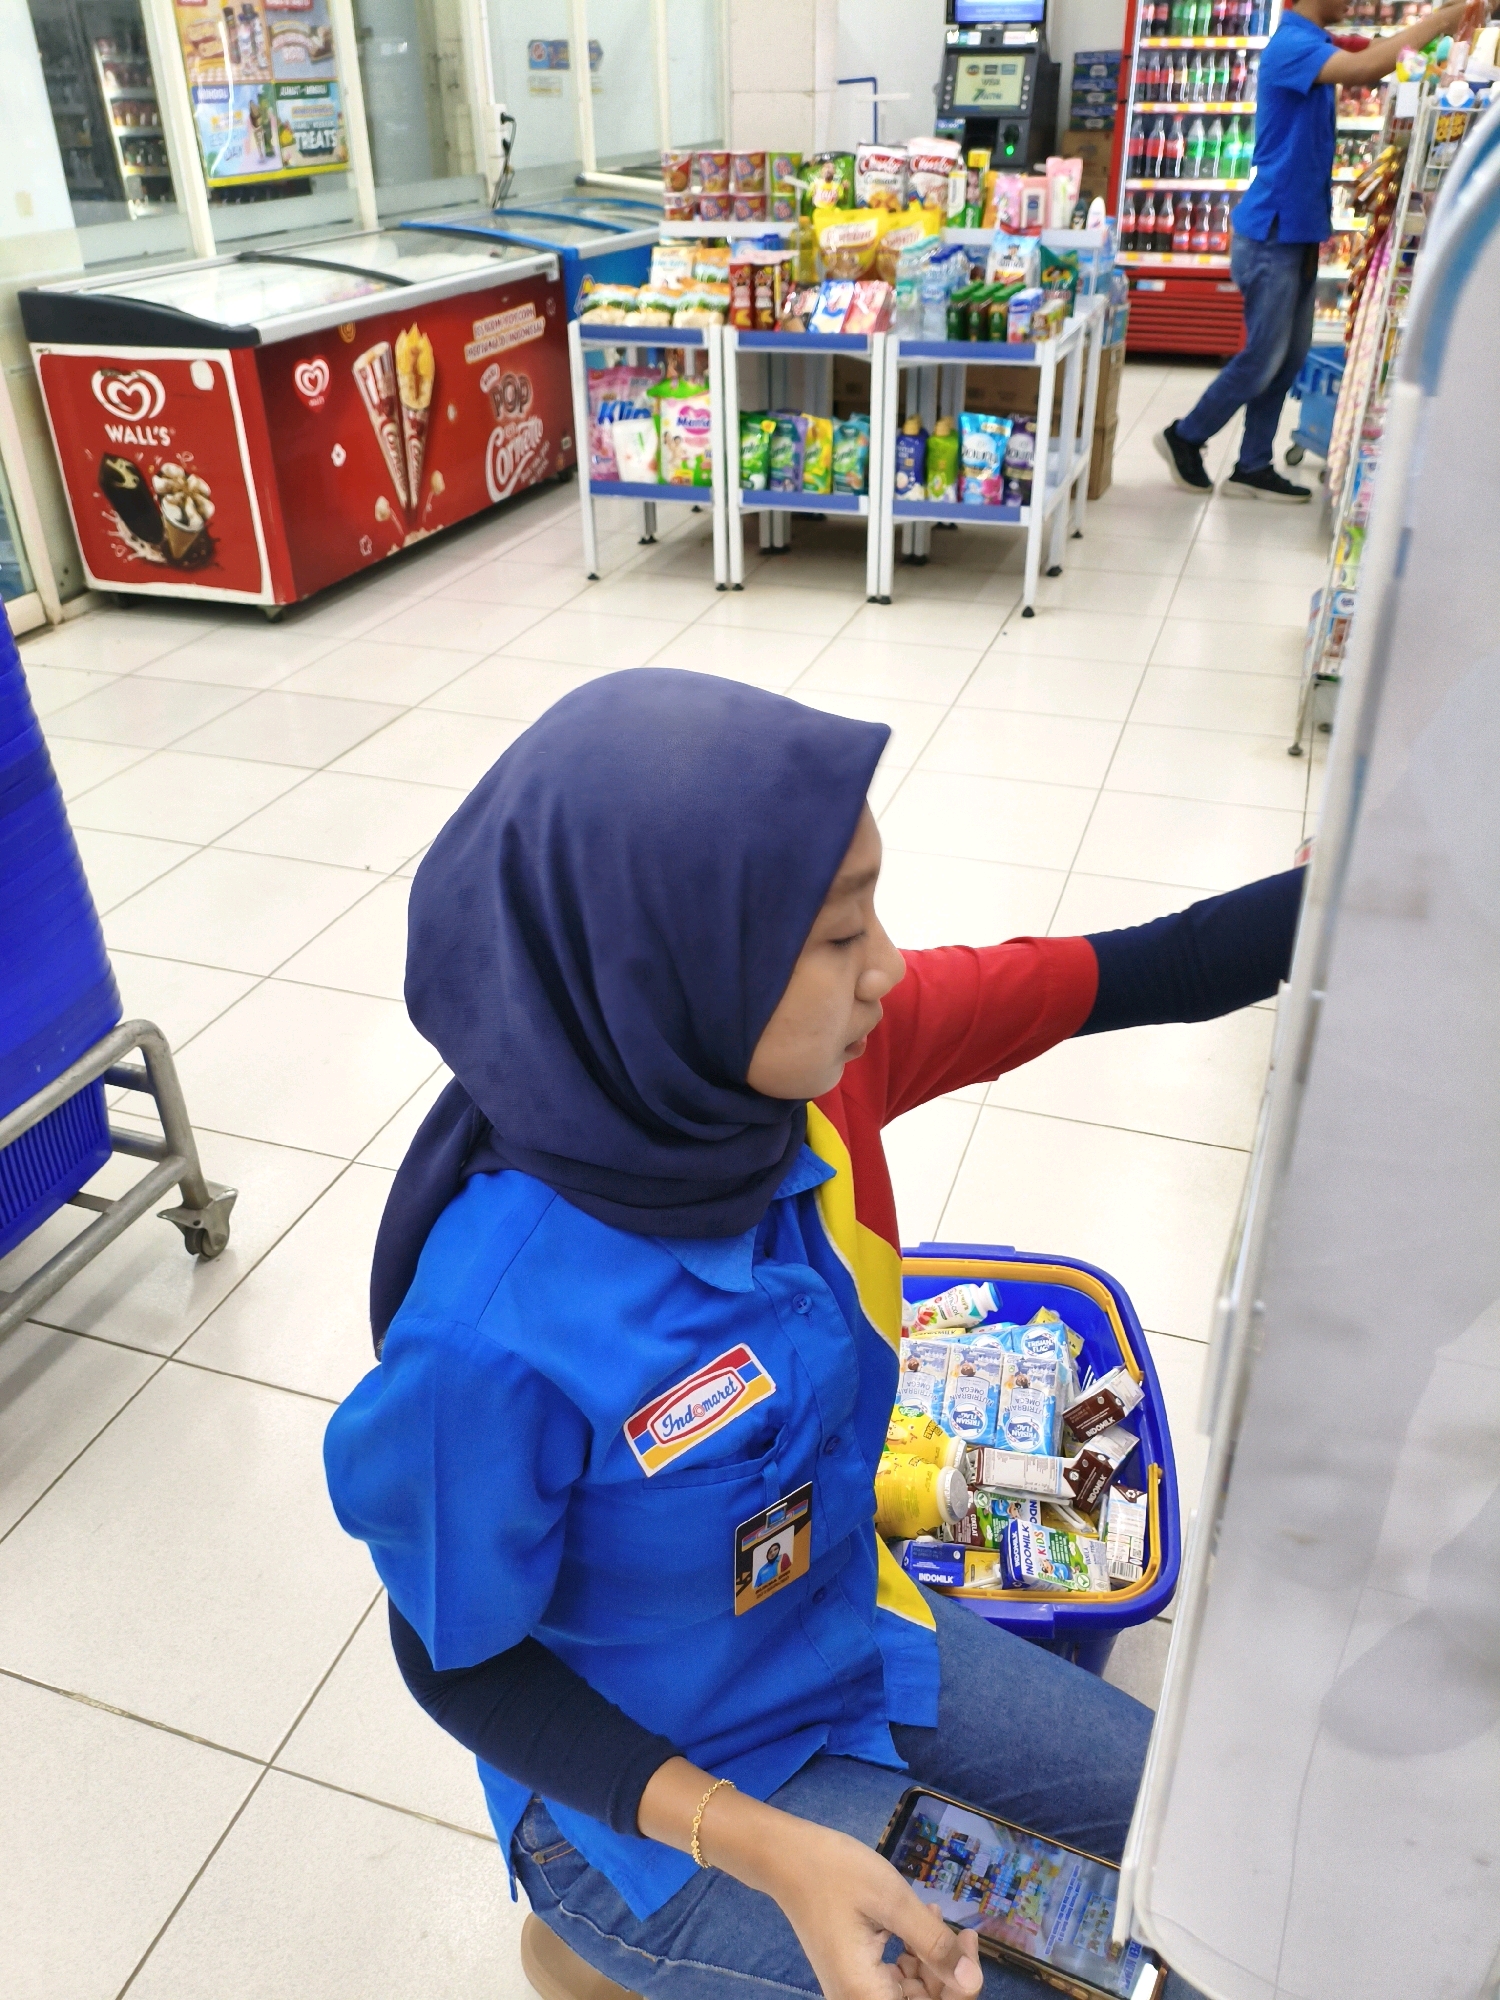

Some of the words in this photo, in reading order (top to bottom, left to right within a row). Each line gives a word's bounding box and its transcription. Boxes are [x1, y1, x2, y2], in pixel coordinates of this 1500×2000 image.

[104, 423, 172, 448] WALL'S
[959, 1386, 985, 1395] OMEGA
[661, 1376, 739, 1438] Indomaret
[948, 1393, 993, 1407] NUTRIBRAIN
[1014, 1397, 1041, 1407] OMEGA
[1003, 1405, 1044, 1417] UTRIBRAIN
[956, 1416, 982, 1427] FRISIAN
[1085, 1416, 1117, 1441] INDOMILK
[1011, 1429, 1037, 1439] FRISIAN
[1087, 1472, 1109, 1503] INDOMILK
[1012, 1531, 1021, 1567] INDOMILK
[1021, 1524, 1035, 1576] INDOMILK
[918, 1572, 954, 1584] INDOMILK
